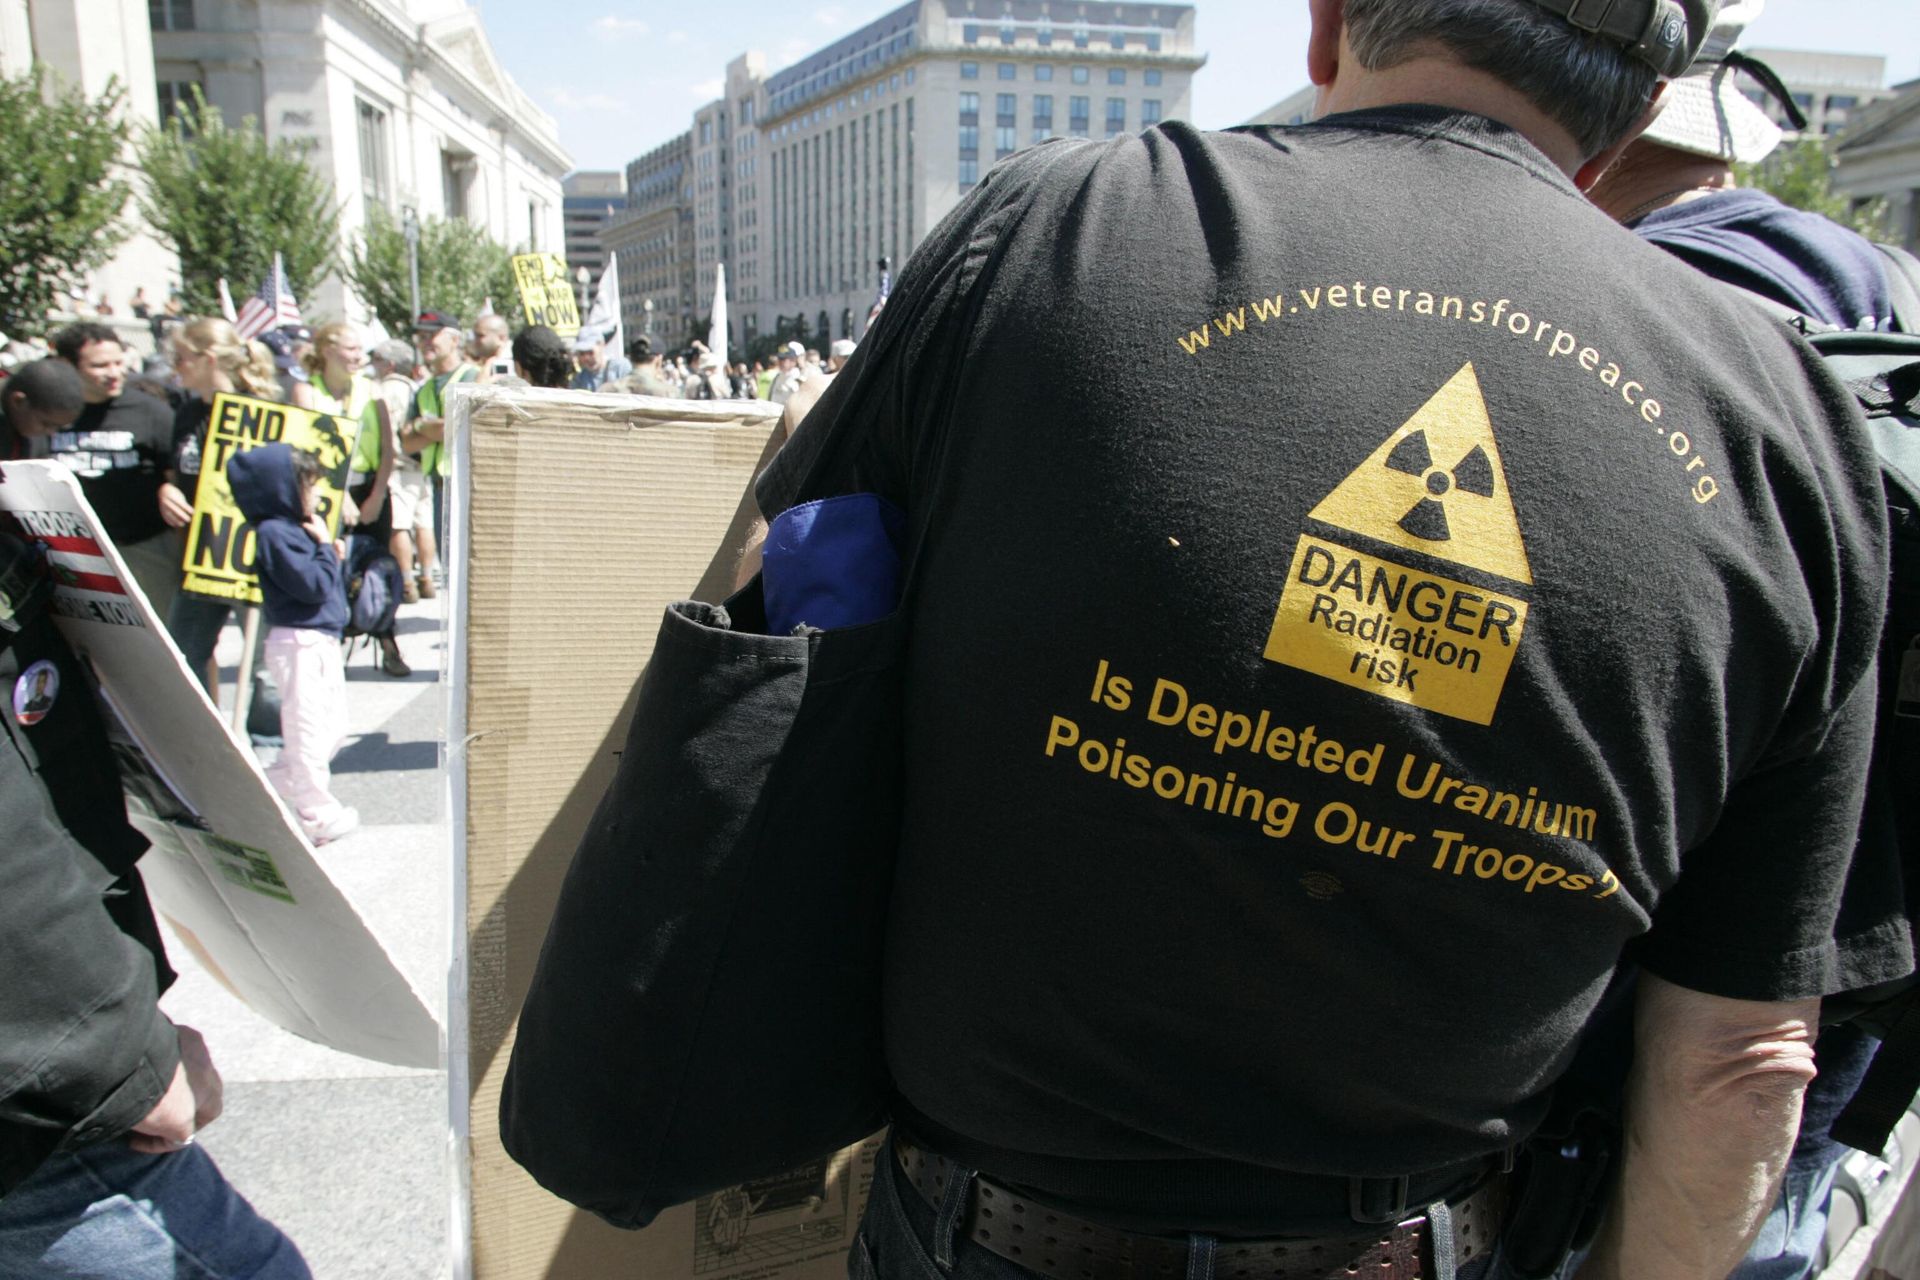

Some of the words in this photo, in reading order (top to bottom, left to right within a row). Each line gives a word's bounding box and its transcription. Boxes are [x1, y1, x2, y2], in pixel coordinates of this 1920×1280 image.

[518, 259, 544, 273] END
[520, 273, 547, 289] THE
[531, 303, 575, 326] NOW
[1177, 281, 1719, 504] www.veteransforpeace.org
[218, 401, 285, 442] END
[12, 511, 96, 538] TROOPS
[194, 512, 257, 574] NO
[96, 600, 145, 628] NOW
[1298, 544, 1518, 646] DANGER
[1308, 593, 1481, 673] Radiation
[1350, 649, 1419, 692] risk
[1090, 659, 1133, 711] Is
[1147, 677, 1385, 786] Depleted
[1395, 753, 1597, 841] Uranium
[1045, 714, 1300, 838] Poisoning
[1314, 801, 1416, 859] Our
[1432, 829, 1619, 899] Troops?
